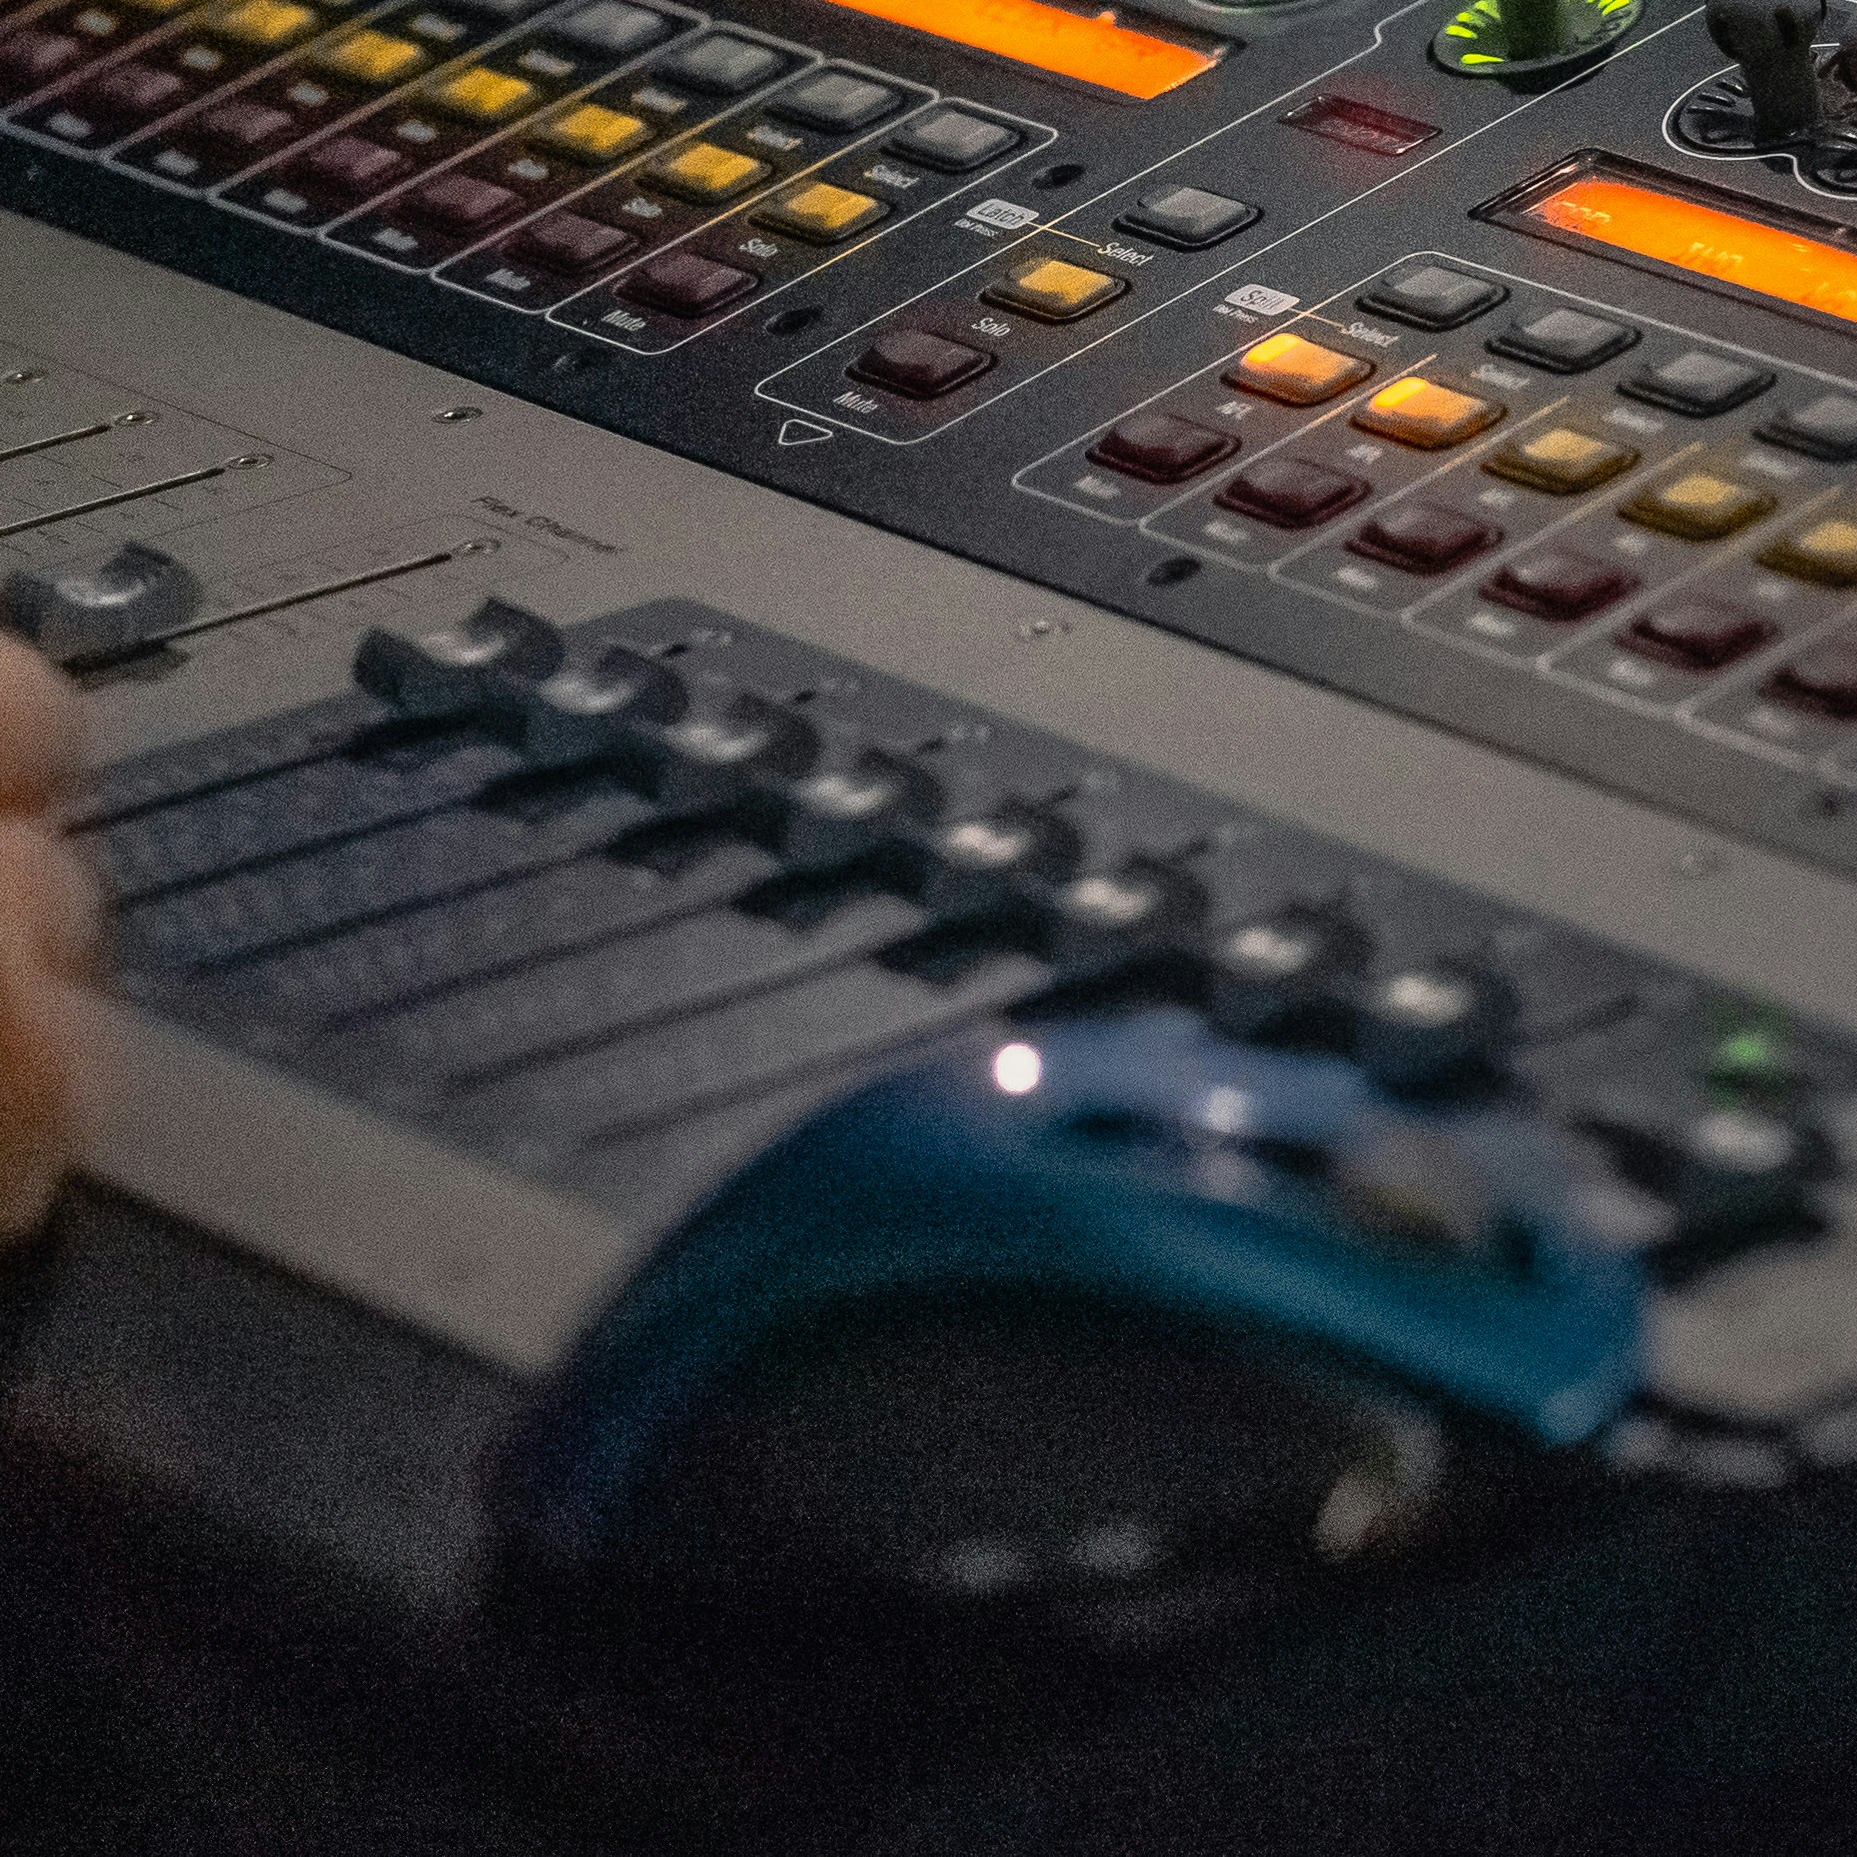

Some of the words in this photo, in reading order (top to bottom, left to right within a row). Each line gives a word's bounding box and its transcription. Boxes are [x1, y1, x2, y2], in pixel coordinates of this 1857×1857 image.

[977, 205, 1027, 227] Latch
[1098, 242, 1154, 266] Select
[1240, 289, 1287, 310] Spill
[971, 317, 1011, 337] Solo
[1346, 322, 1400, 348] Select
[833, 391, 879, 414] Mute
